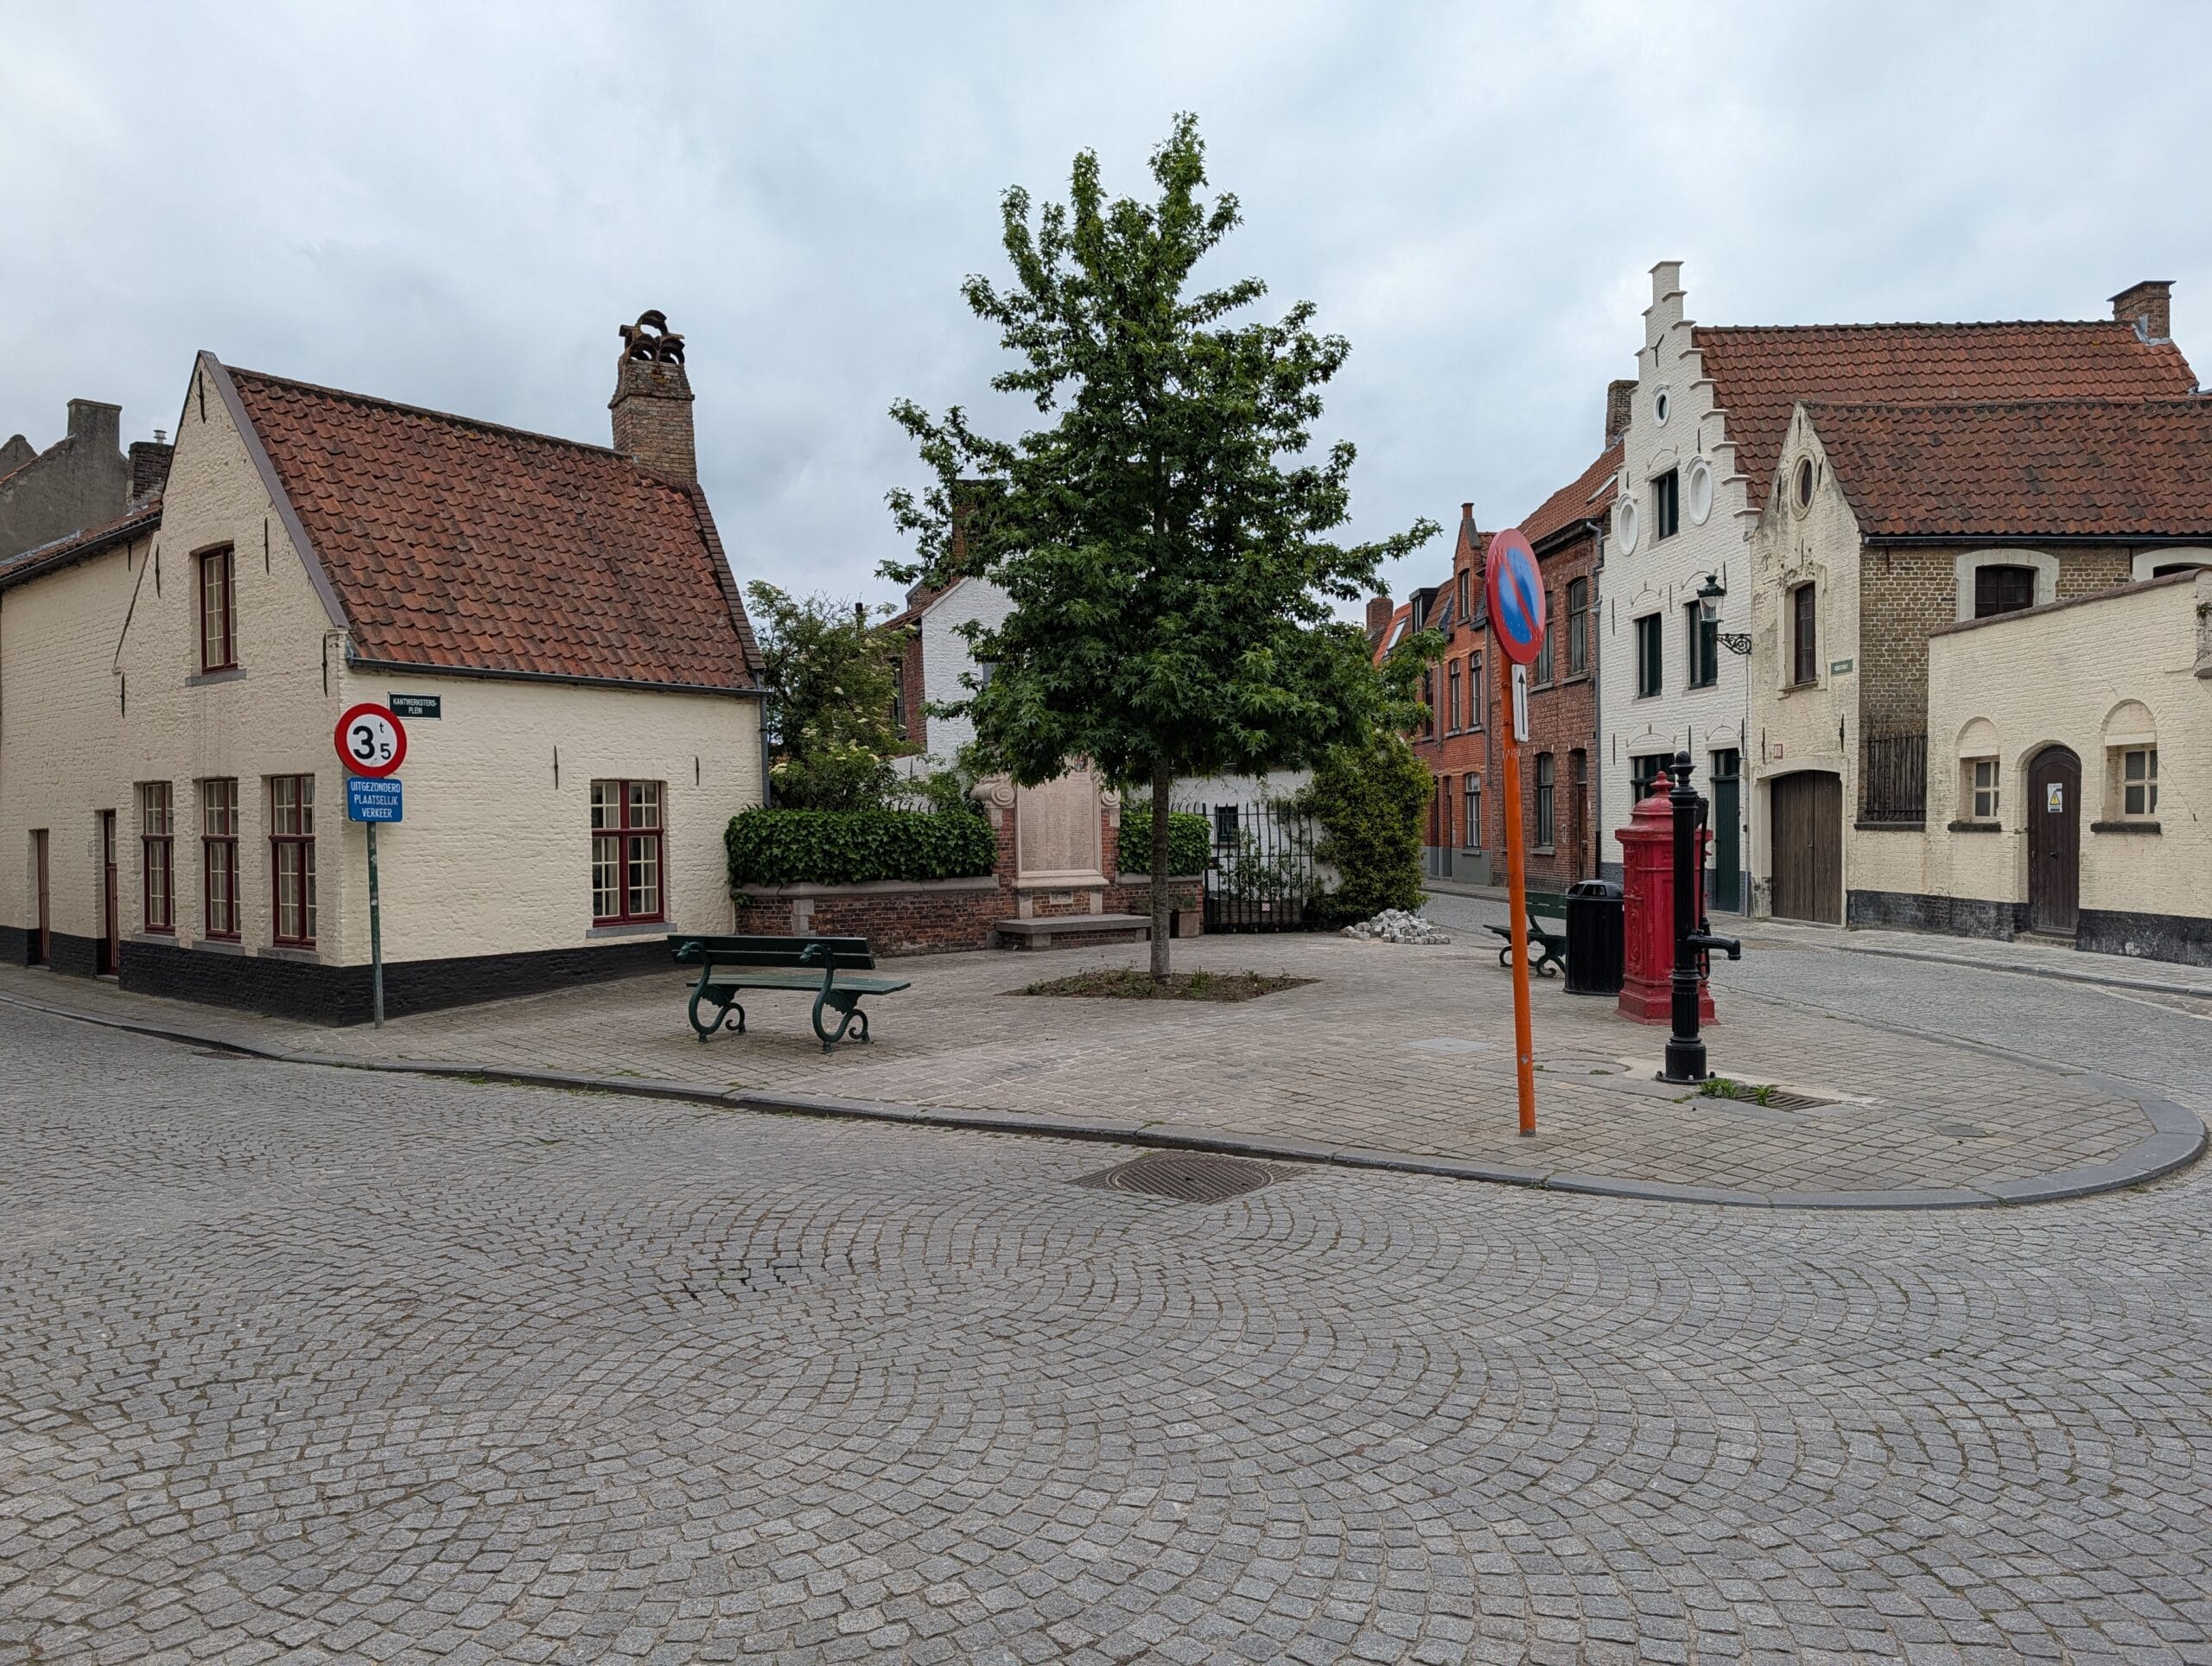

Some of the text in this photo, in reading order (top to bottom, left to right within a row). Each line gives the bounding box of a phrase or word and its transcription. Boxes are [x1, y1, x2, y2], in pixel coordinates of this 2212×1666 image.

[408, 706, 423, 715] PLEIN
[353, 722, 391, 760] 3 t 5
[350, 780, 401, 793] UITGEZONDERD
[353, 794, 398, 805] PLAATSELIJK
[361, 807, 392, 818] VERKEER
